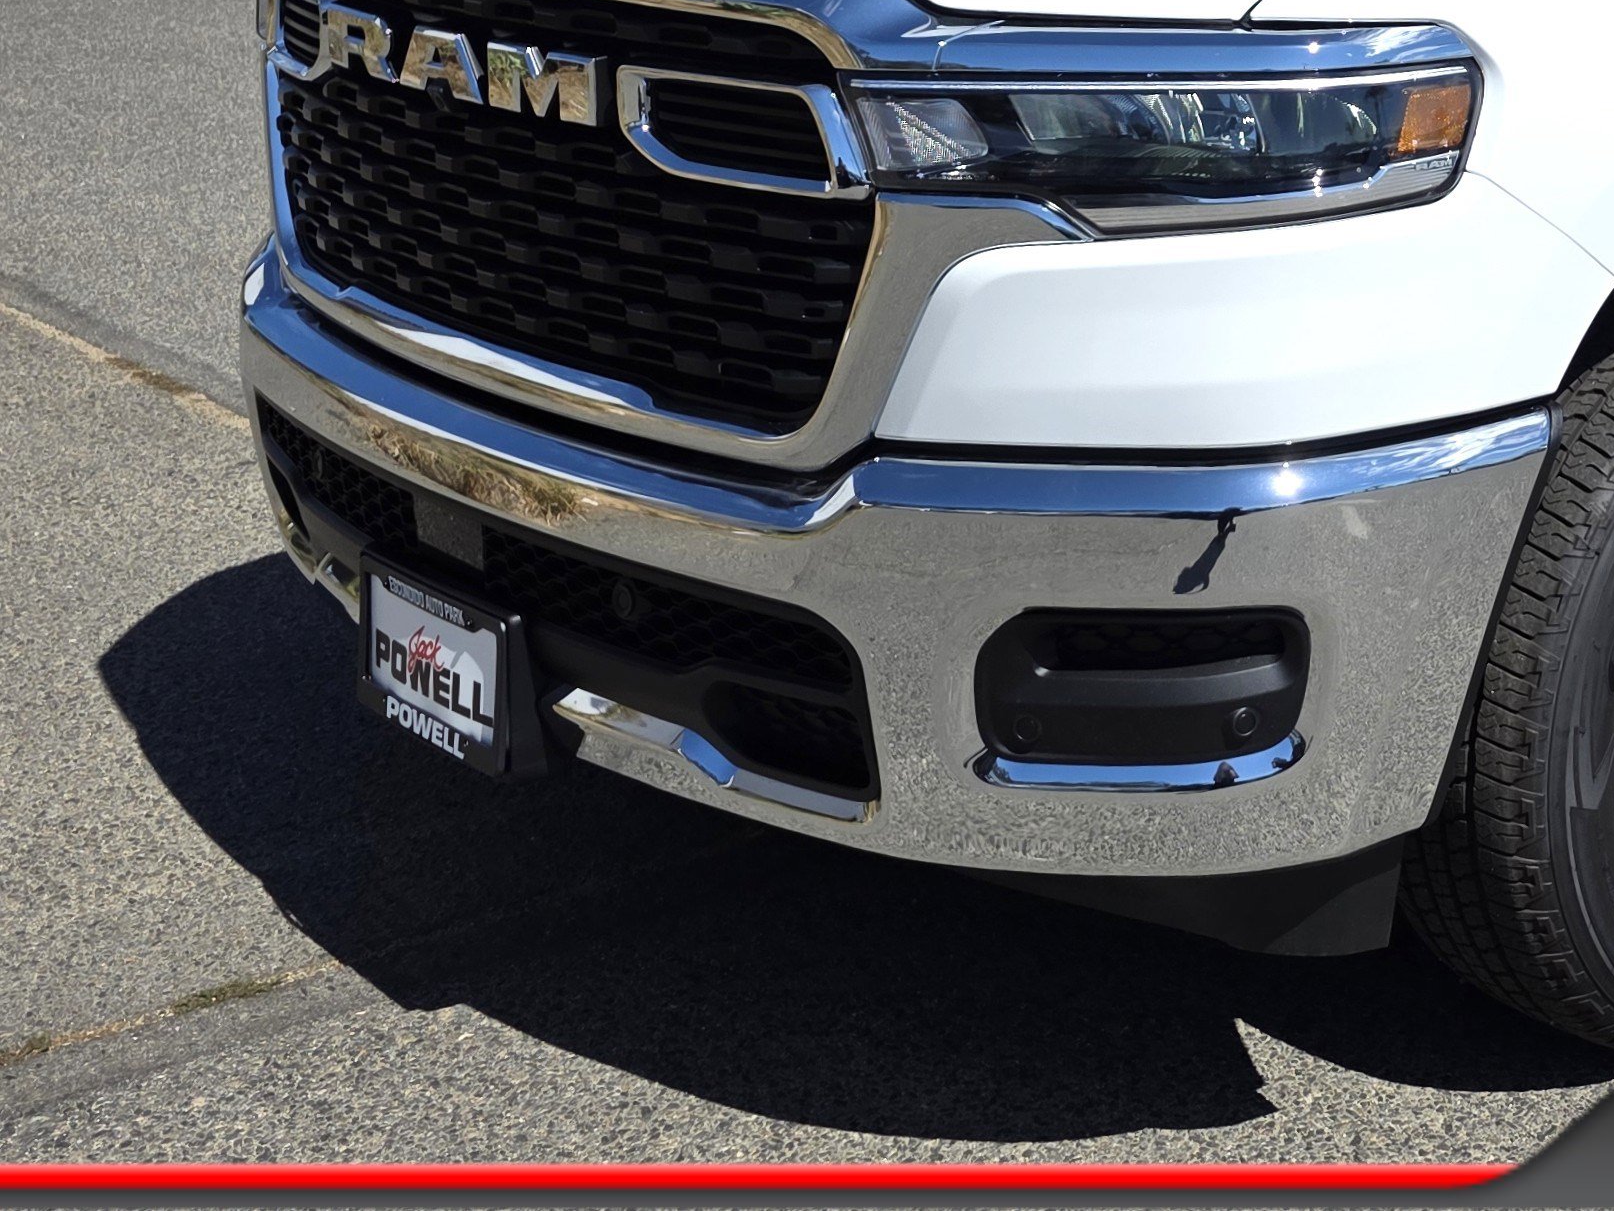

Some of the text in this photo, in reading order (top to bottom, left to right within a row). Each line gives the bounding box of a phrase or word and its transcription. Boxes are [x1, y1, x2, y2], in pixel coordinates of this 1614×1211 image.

[375, 628, 494, 728] POWELL
[408, 626, 445, 673] Jack
[386, 695, 466, 761] POWELL
